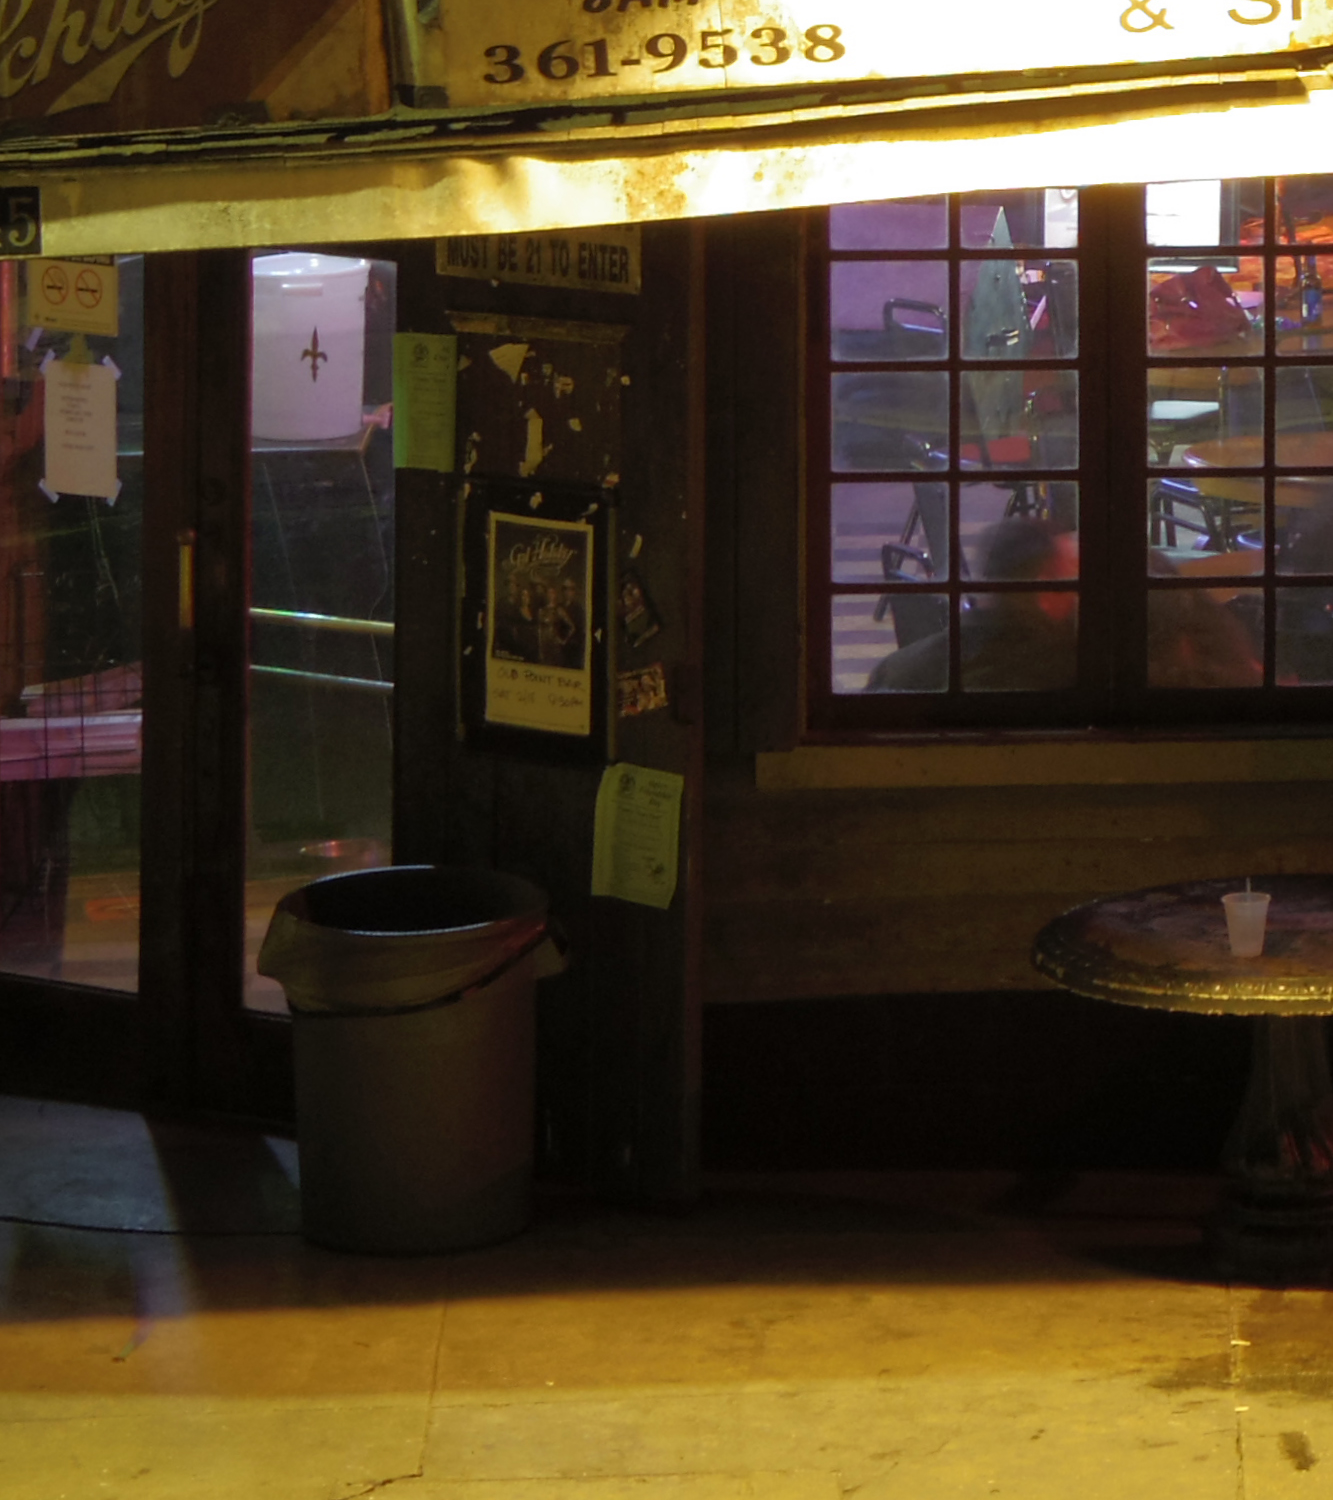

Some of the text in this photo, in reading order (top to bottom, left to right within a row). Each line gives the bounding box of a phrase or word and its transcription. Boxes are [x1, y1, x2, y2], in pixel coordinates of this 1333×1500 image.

[483, 24, 846, 84] 361-9538
[447, 235, 629, 284] MUST BE 21 TO ENTER
